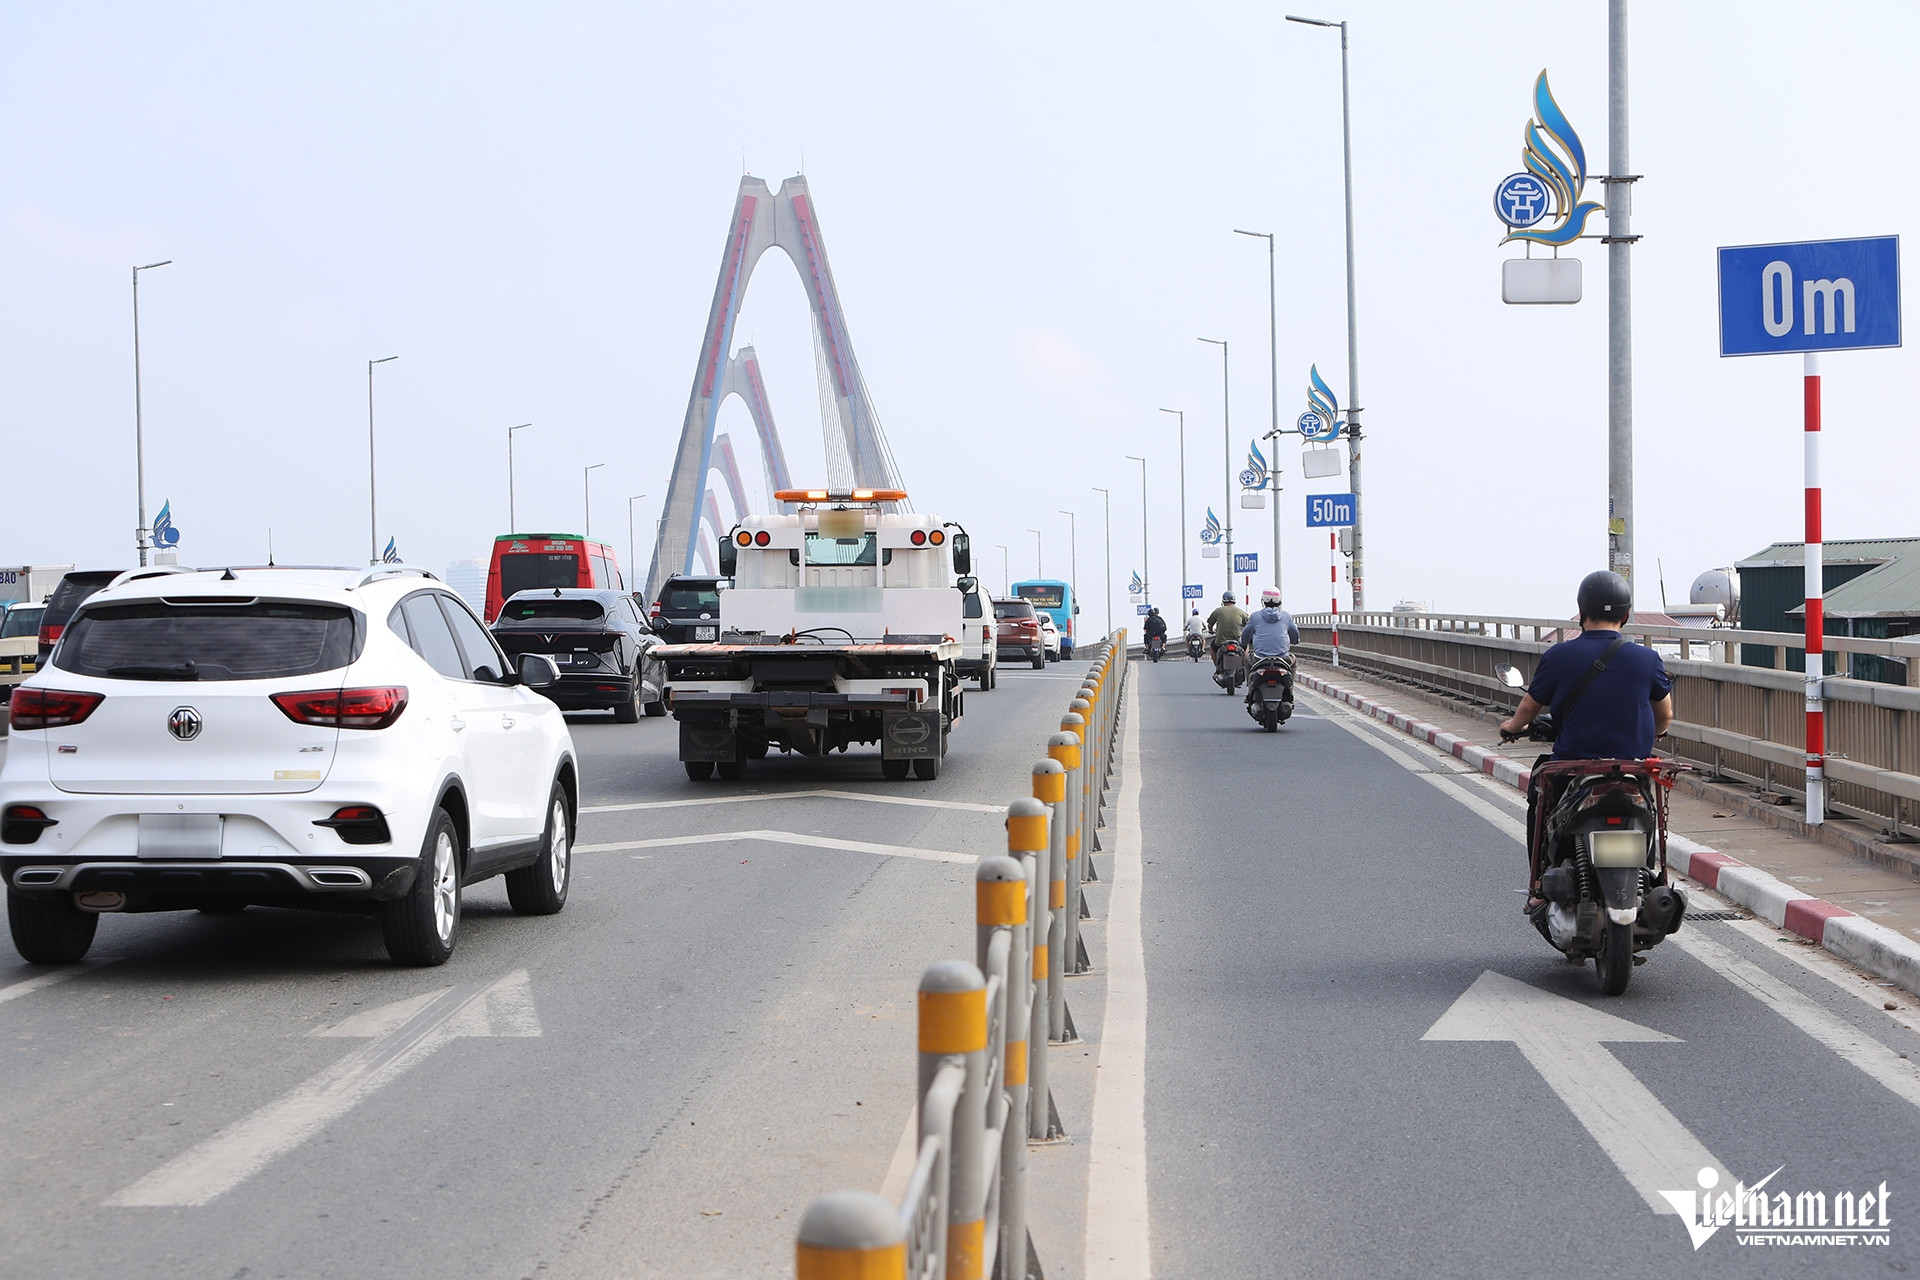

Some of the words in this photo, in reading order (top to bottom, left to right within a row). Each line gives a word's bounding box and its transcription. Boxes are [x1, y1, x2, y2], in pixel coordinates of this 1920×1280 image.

[1762, 260, 1856, 337] 0m
[1313, 498, 1350, 522] 50m
[1236, 556, 1256, 570] 100m
[1184, 586, 1201, 597] 150m
[170, 709, 199, 738] MG
